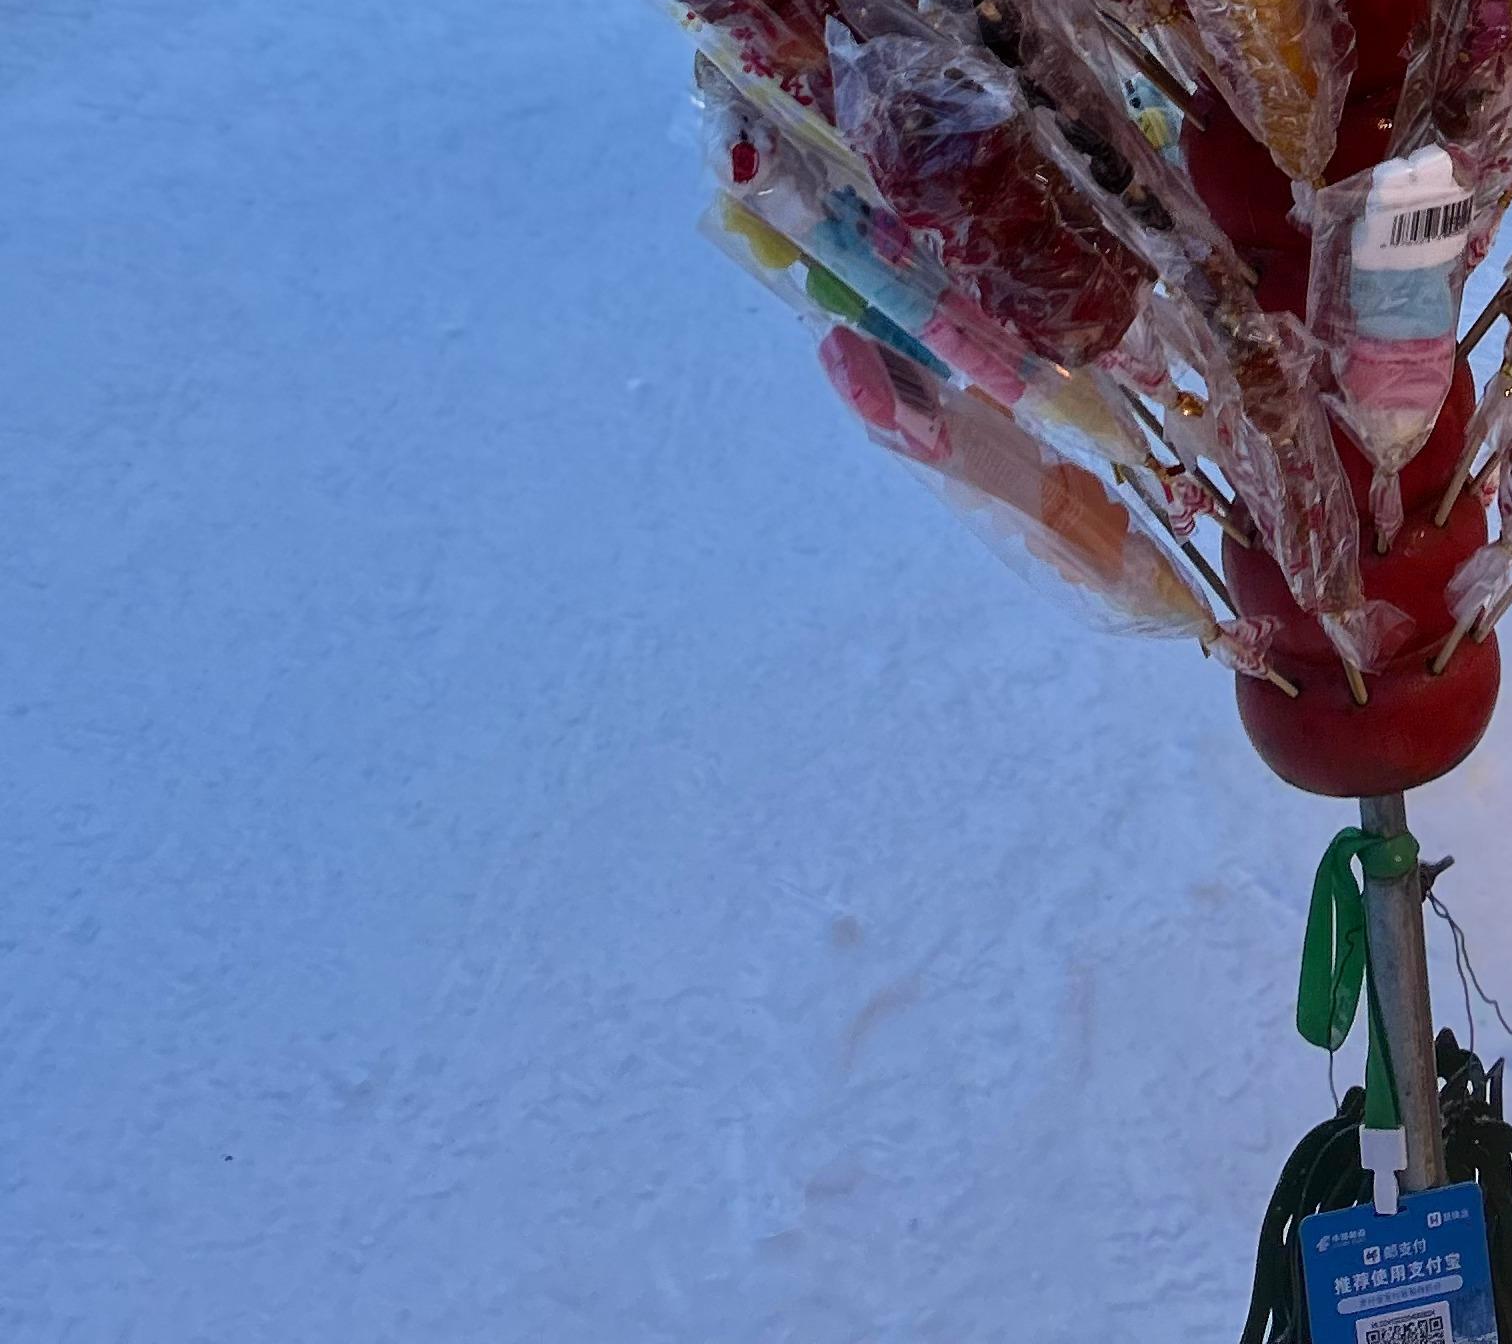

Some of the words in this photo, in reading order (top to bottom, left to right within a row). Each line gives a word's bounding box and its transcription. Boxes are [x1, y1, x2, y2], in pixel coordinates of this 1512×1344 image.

[1334, 1252, 1462, 1295] 推荐使用支付宝
